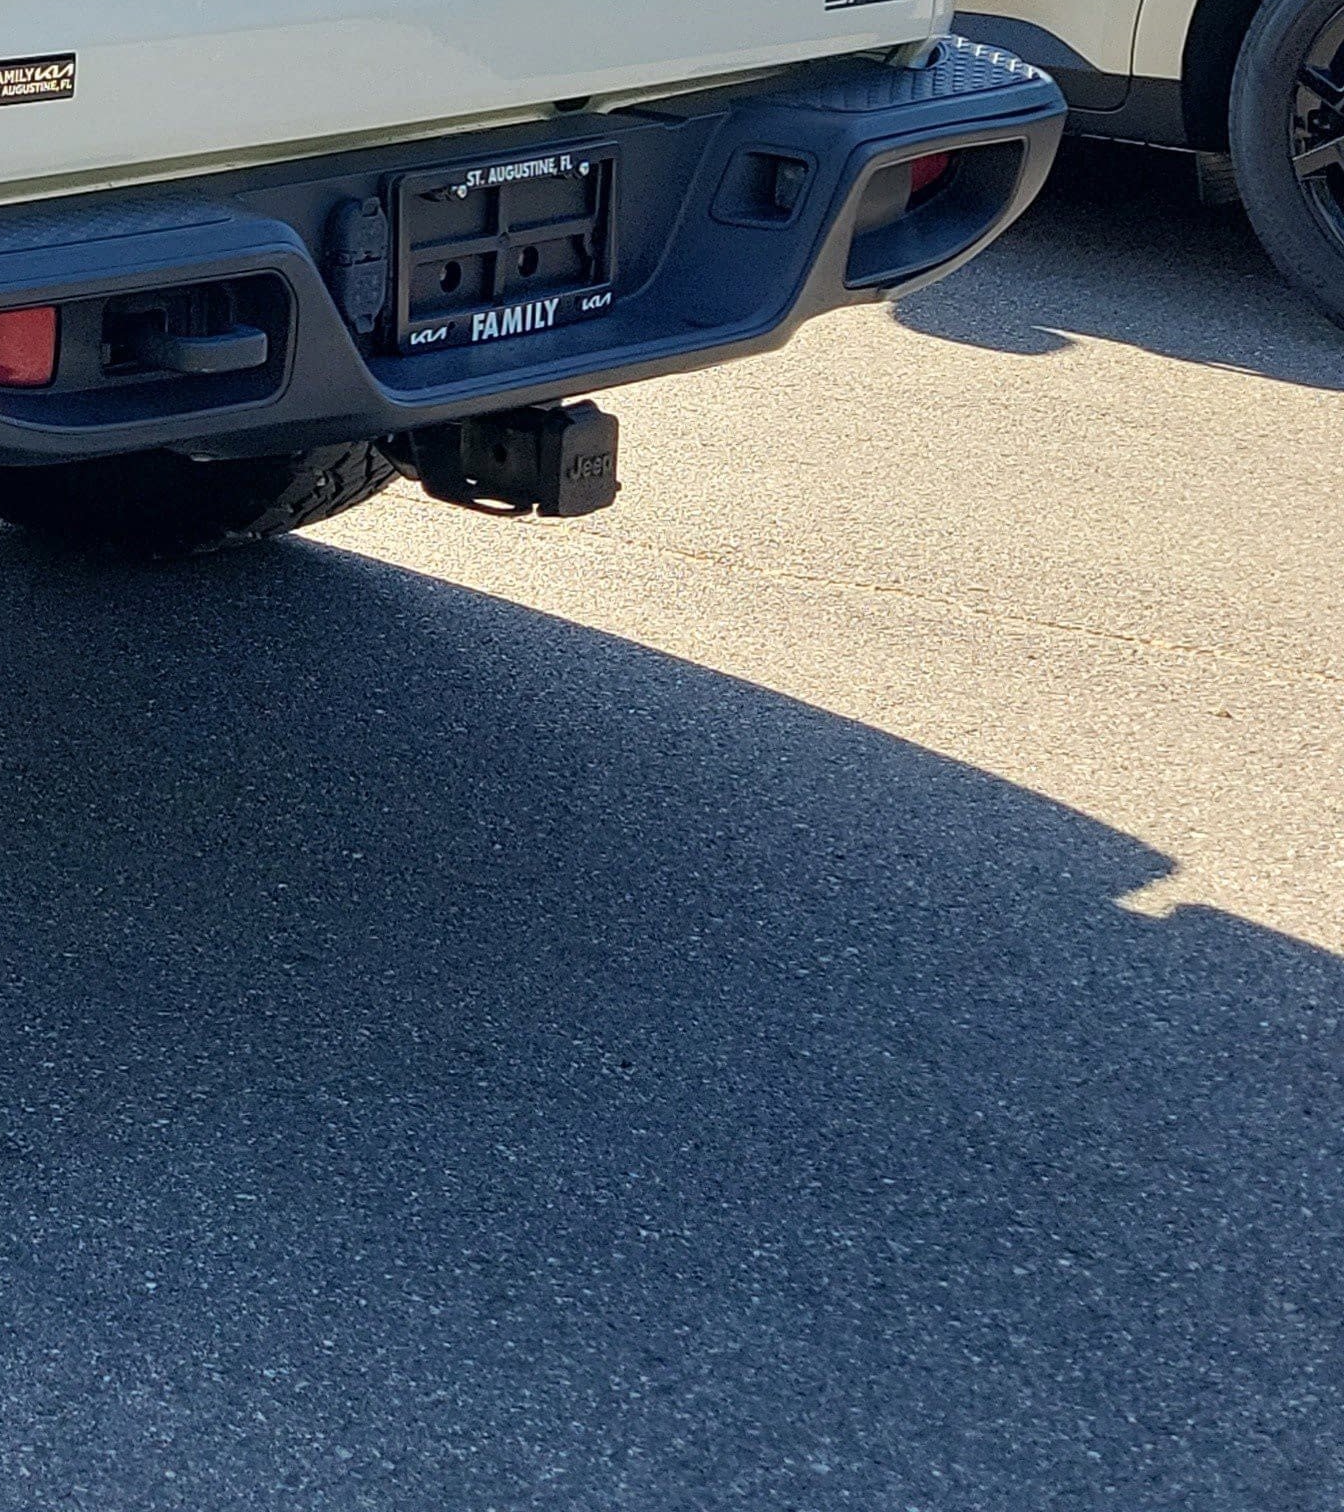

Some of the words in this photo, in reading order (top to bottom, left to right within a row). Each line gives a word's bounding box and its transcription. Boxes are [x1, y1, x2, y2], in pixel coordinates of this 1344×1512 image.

[35, 64, 74, 80] KIA
[2, 80, 60, 96] AUGUSTINE,
[60, 79, 72, 90] FL
[467, 171, 485, 186] ST.
[488, 157, 558, 184] AUGUSTINE,
[560, 155, 572, 171] FL
[411, 326, 449, 345] KIA
[472, 298, 559, 341] FAMILY
[582, 292, 612, 311] KIA
[566, 453, 612, 480] Jeep
